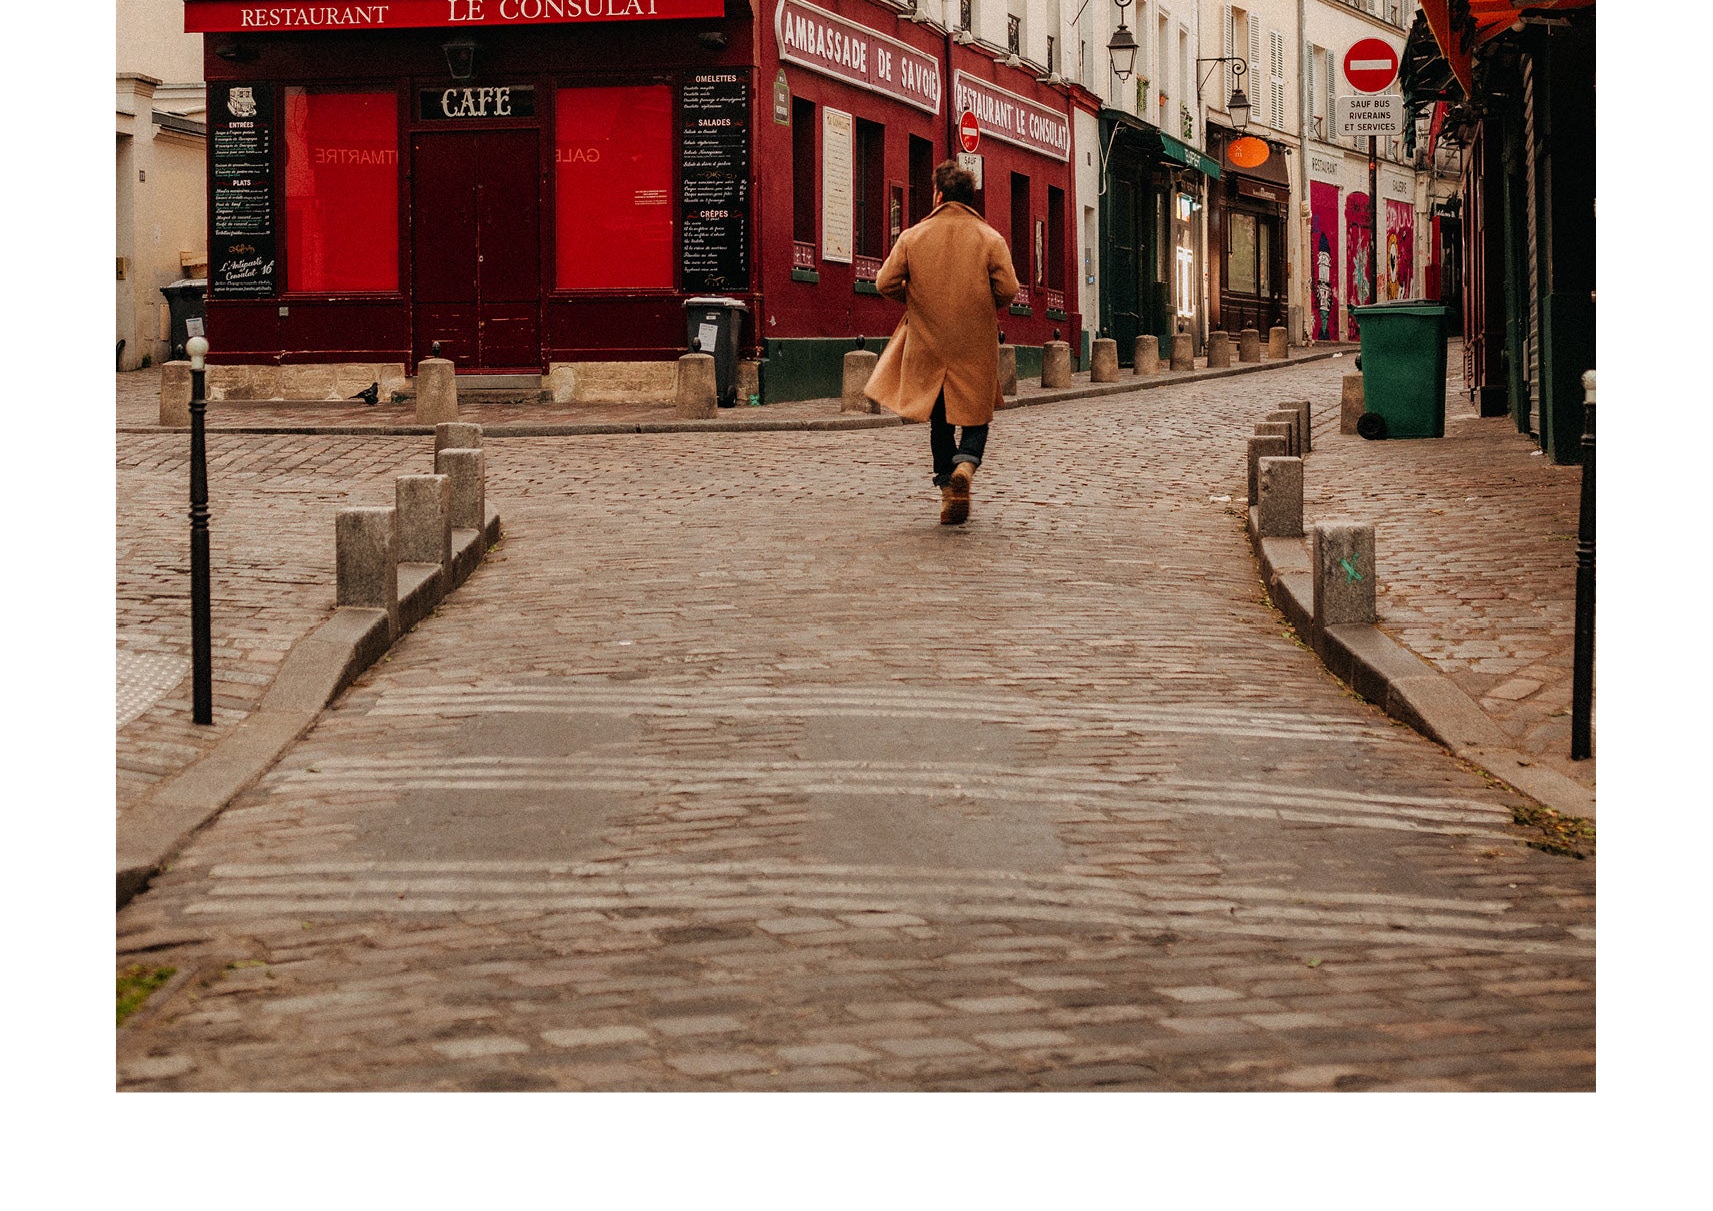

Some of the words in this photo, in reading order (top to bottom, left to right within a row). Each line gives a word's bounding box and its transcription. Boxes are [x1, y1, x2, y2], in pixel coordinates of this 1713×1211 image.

[241, 5, 389, 27] RESTAURANT
[784, 11, 867, 73] AMBASSADE
[878, 47, 892, 82] DE
[901, 57, 937, 101] SAVOIE
[695, 75, 737, 83] OMELETTES
[440, 86, 512, 118] CAFE
[1350, 100, 1371, 108] SAUF
[1374, 100, 1390, 108] BUS
[957, 83, 1014, 130] RESTAURANT
[1016, 107, 1026, 136] LE
[1029, 113, 1067, 150] CONSULAT
[1349, 111, 1391, 119] RIVERAINS
[1344, 123, 1355, 131] ET
[1357, 123, 1396, 131] SERVICES
[700, 209, 729, 218] CRÊPES
